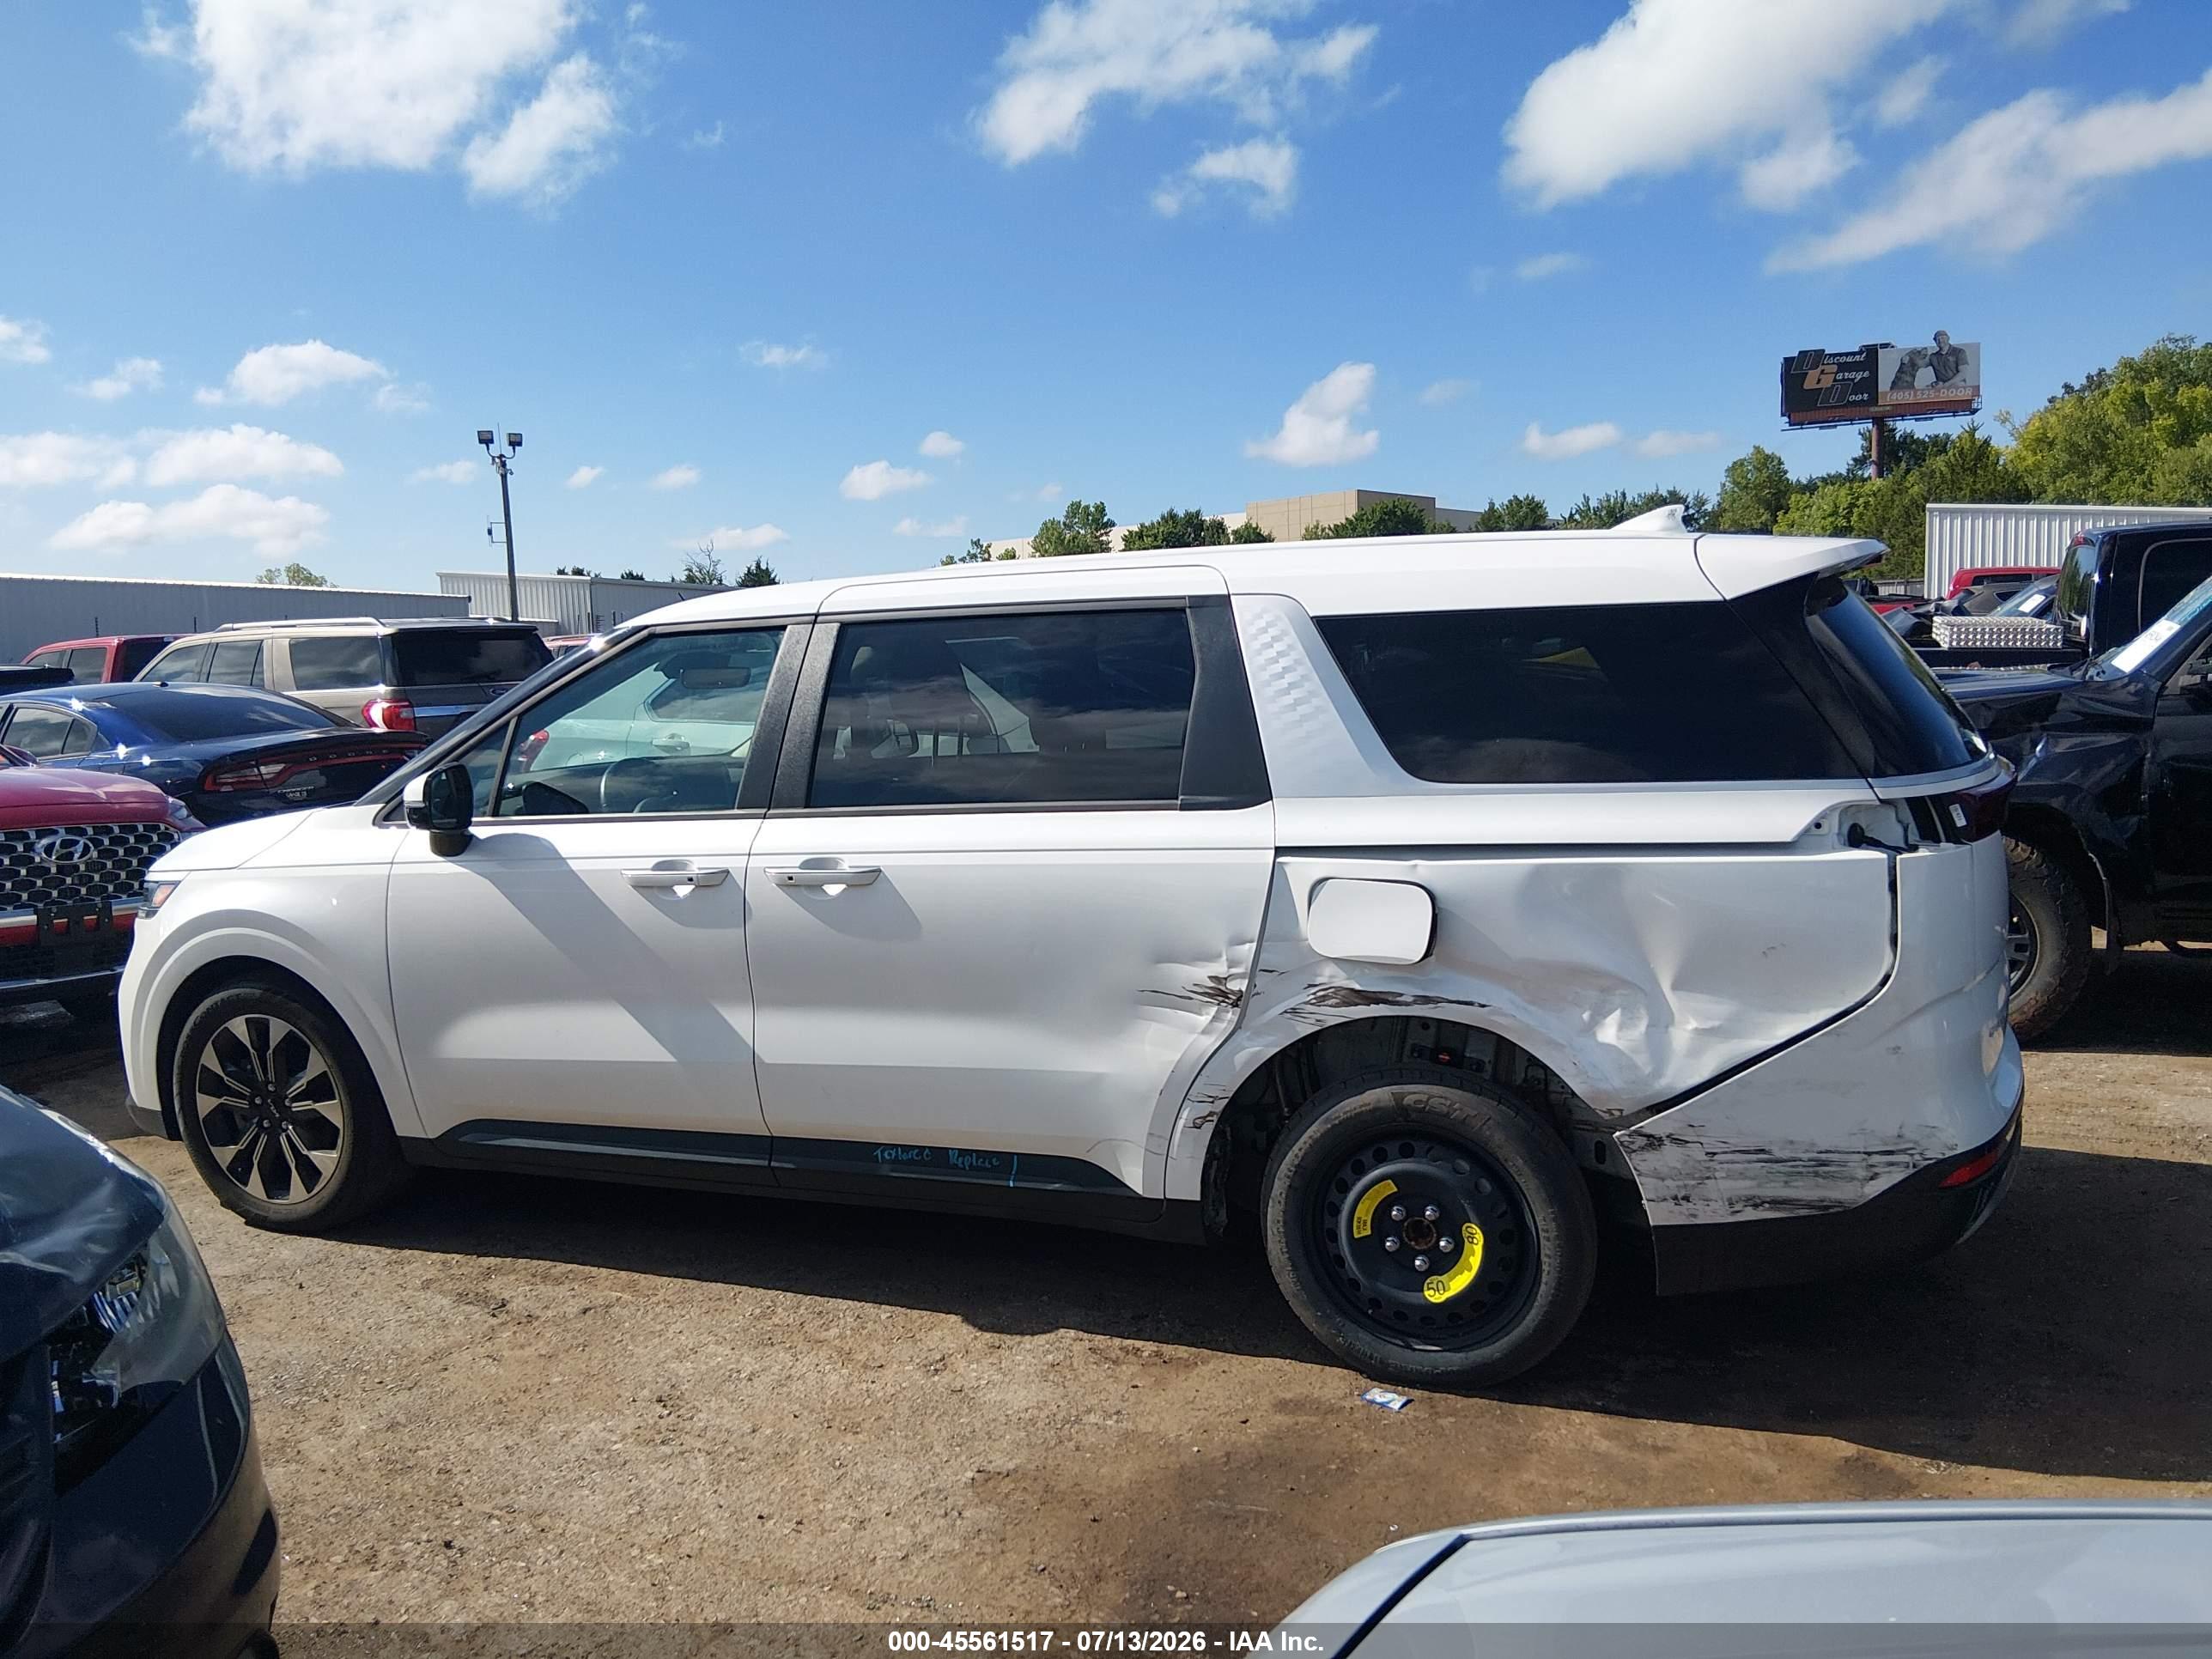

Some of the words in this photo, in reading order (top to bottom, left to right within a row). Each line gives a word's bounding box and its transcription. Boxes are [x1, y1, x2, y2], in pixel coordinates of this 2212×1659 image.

[1790, 349, 1867, 374] Discount
[1803, 364, 1870, 390] Garage
[1817, 381, 1869, 407] Door
[1887, 391, 1914, 401] (405)
[1916, 387, 1973, 399] 525-DOOR
[1465, 1224, 1479, 1246] 80
[1426, 1279, 1446, 1297] 50
